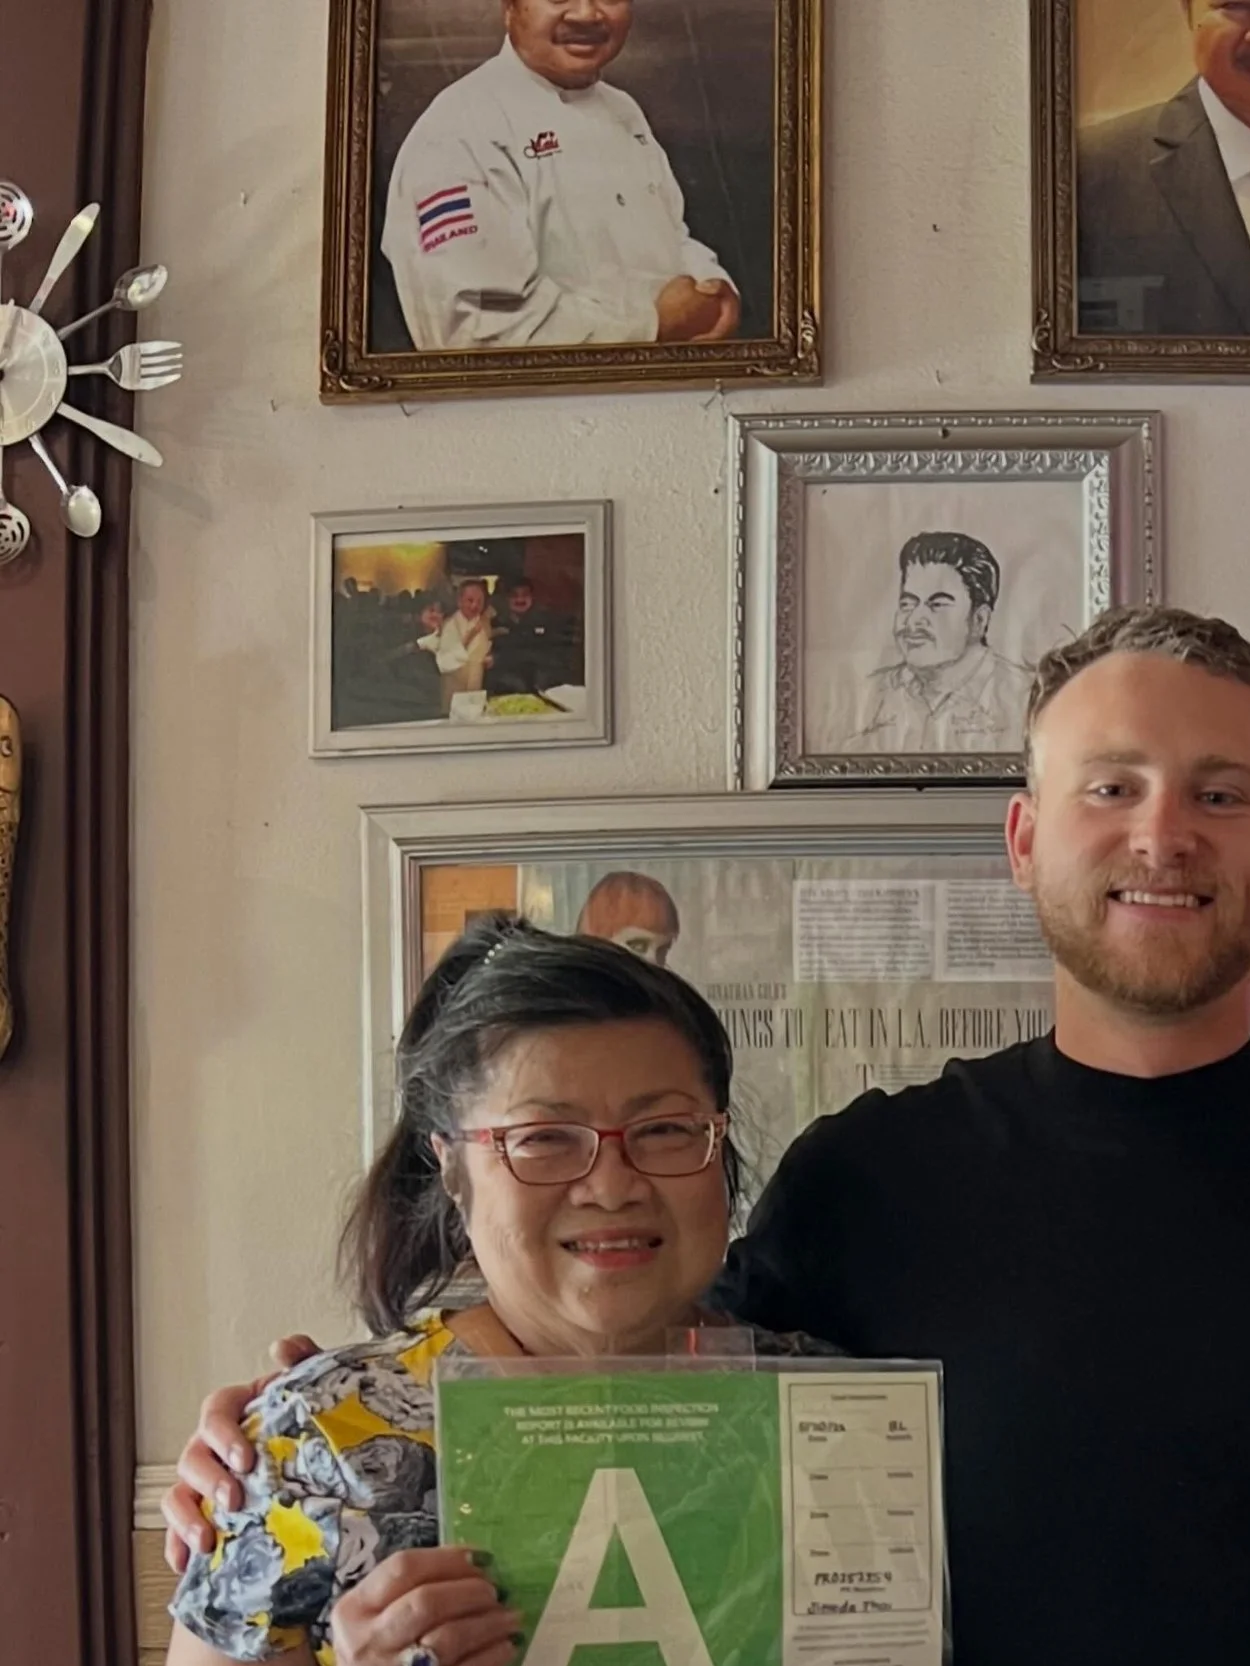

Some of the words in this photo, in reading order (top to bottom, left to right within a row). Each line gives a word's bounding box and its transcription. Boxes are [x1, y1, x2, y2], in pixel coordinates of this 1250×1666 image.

[781, 1008, 804, 1048] TO
[825, 1008, 860, 1048] EAT
[869, 1008, 888, 1048] IN
[898, 1008, 932, 1048] L.A.
[939, 1008, 1007, 1048] BEFORE
